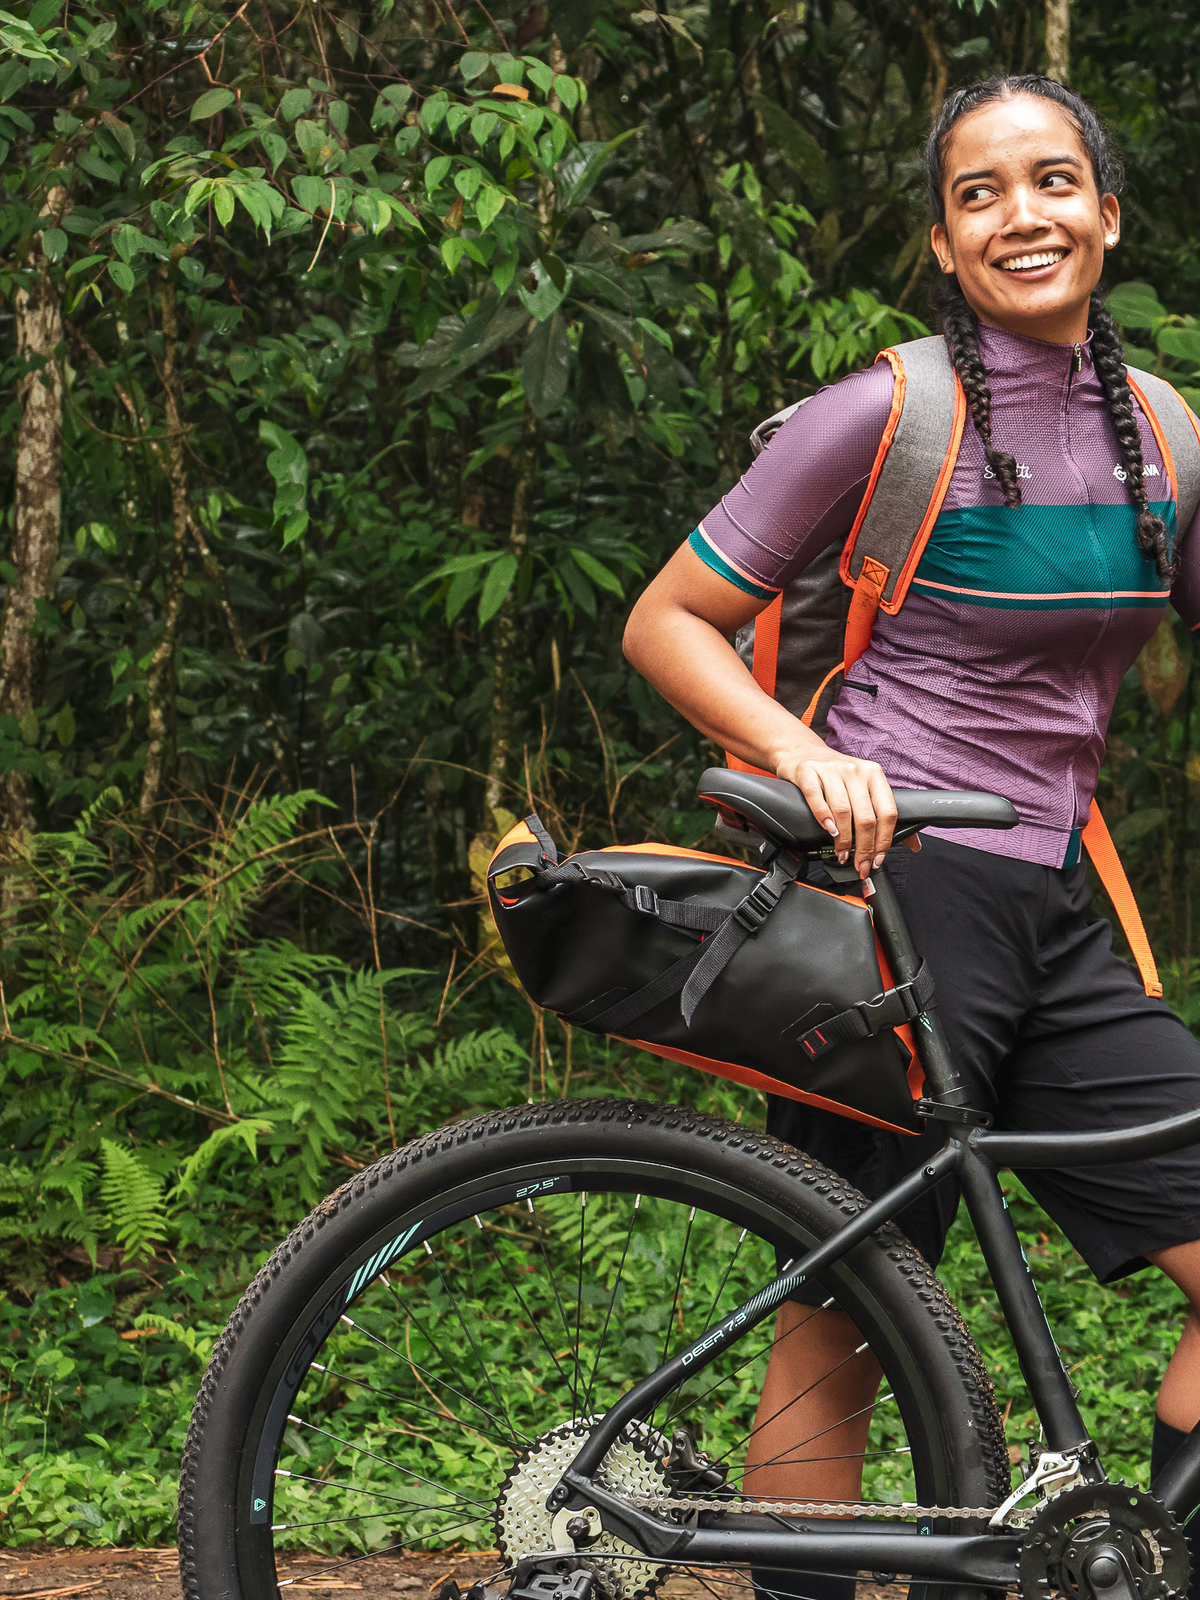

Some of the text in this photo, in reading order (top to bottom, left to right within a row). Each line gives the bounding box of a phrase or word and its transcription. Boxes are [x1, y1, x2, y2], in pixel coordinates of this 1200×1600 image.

[516, 1177, 560, 1198] 27.5"
[682, 1312, 747, 1365] DEER 7.3
